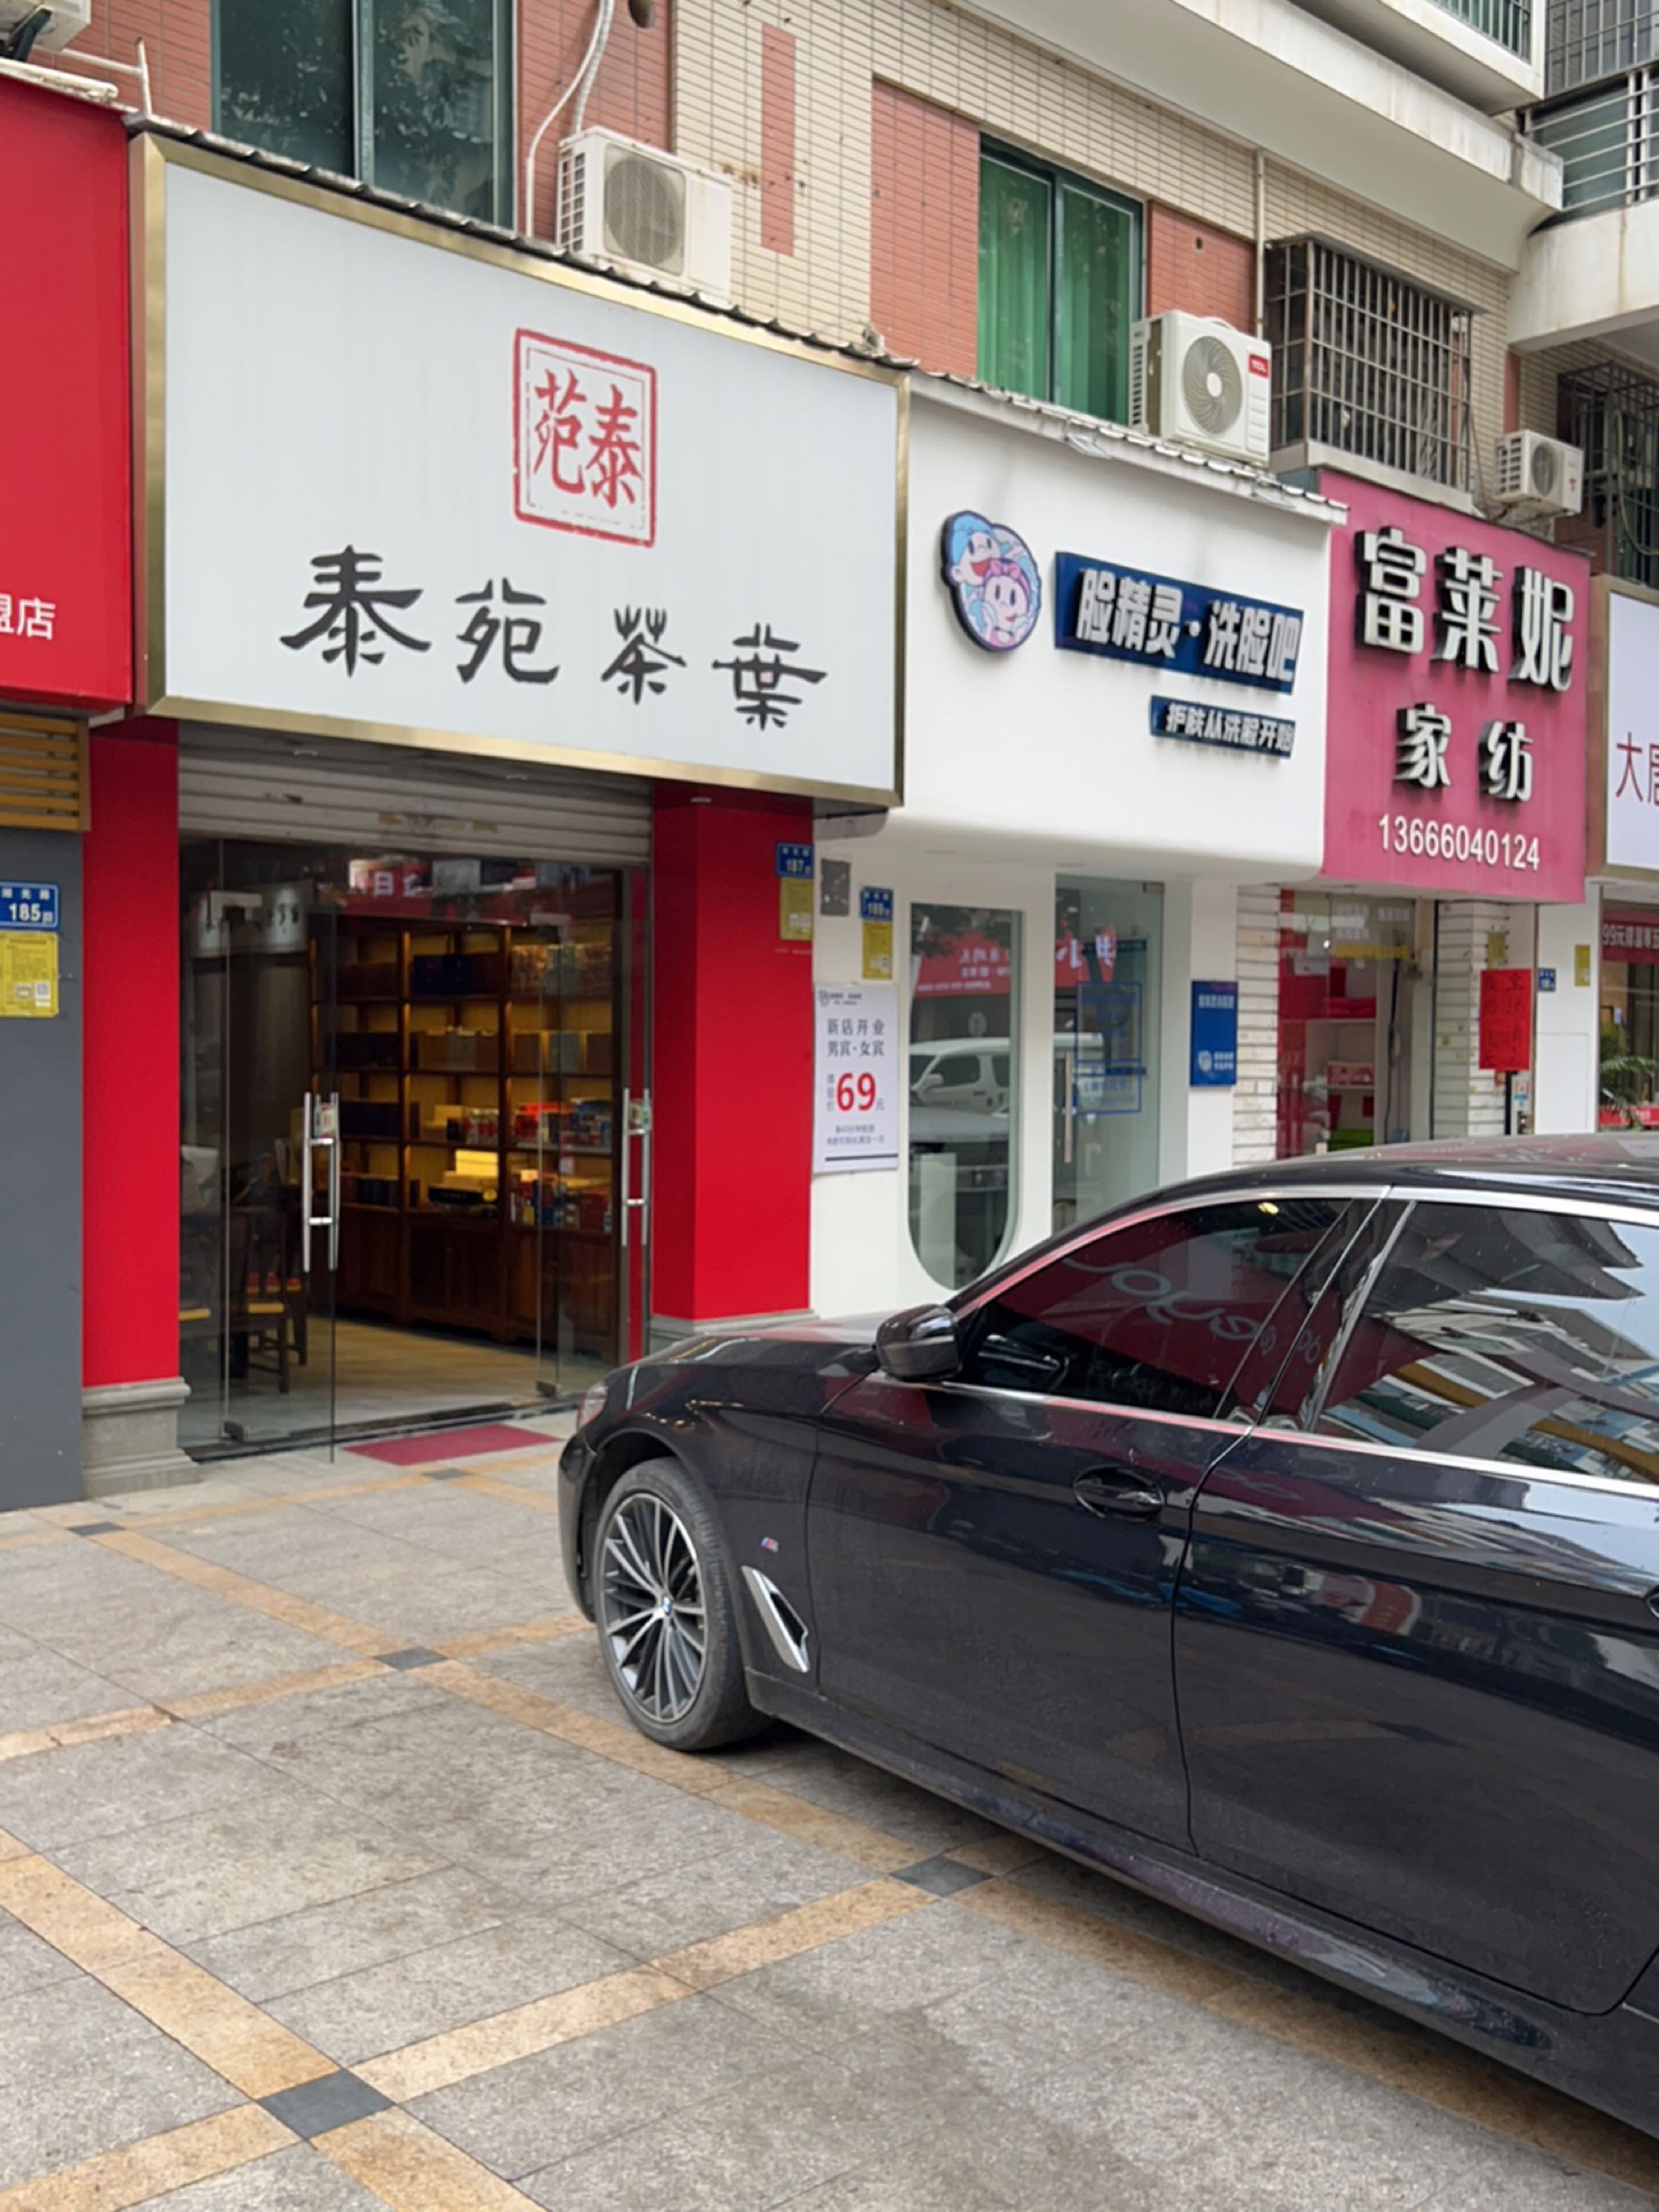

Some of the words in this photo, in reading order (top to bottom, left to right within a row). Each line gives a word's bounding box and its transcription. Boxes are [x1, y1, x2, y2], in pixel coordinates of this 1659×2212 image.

[278, 544, 828, 731] 泰苑茶葉
[1354, 525, 1574, 692] 富莱妮
[1394, 703, 1534, 802] 家纺
[1378, 813, 1540, 871] 13666040124
[828, 1018, 885, 1036] 新店开业
[837, 1072, 876, 1112] 69
